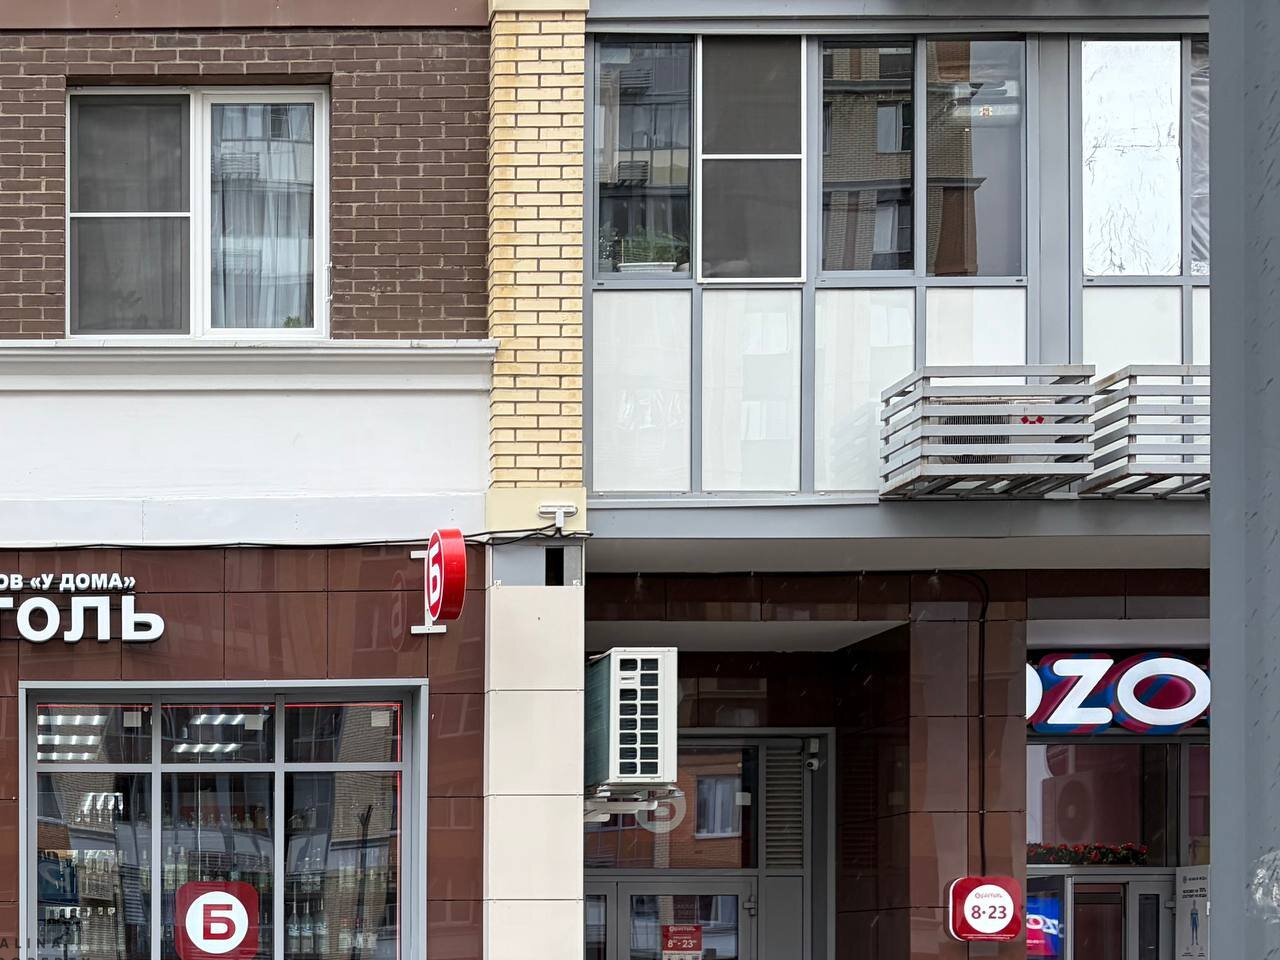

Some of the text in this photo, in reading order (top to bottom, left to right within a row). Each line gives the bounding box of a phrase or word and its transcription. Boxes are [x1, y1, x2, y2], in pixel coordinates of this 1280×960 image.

[30, 574, 55, 591] «У
[59, 573, 137, 592] ДОМА»
[429, 541, 440, 607] Б
[1026, 657, 1211, 726] ZO
[202, 903, 237, 940] Б
